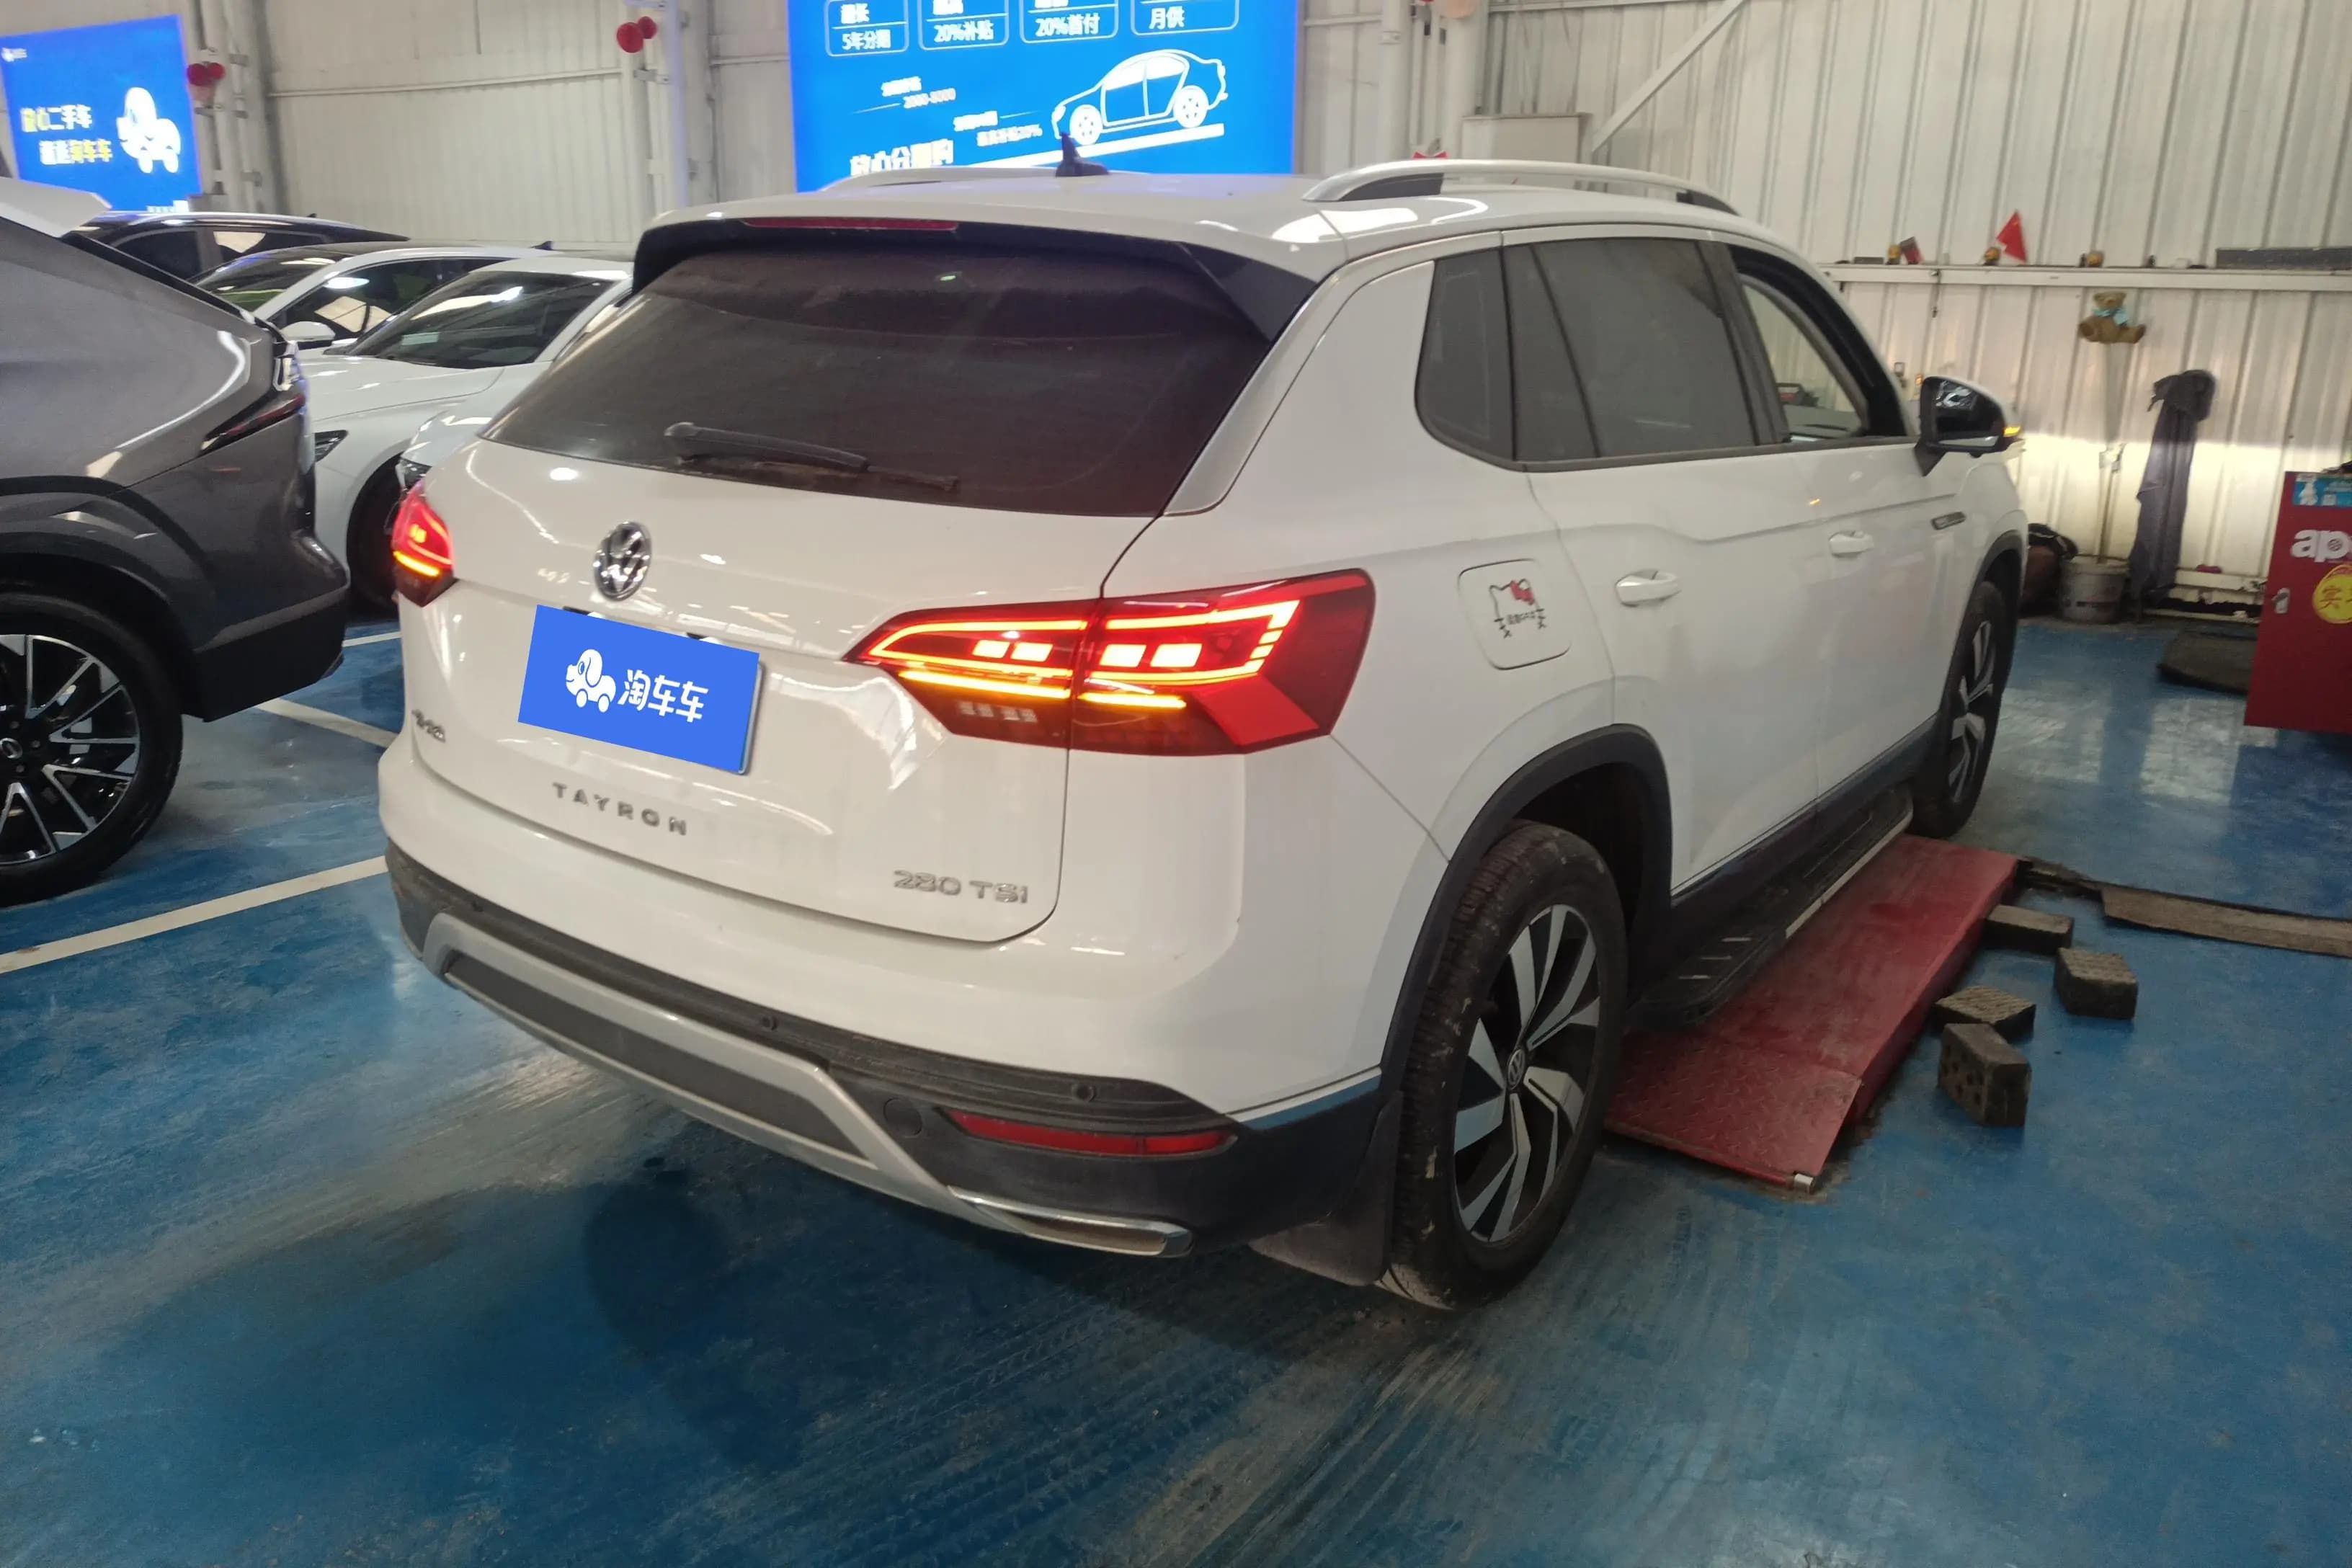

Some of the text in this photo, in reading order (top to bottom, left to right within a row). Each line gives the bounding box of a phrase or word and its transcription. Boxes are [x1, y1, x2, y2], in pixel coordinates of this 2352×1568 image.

[2289, 529, 2352, 564] ap
[552, 782, 687, 836] TAYRON
[894, 869, 962, 896] 280
